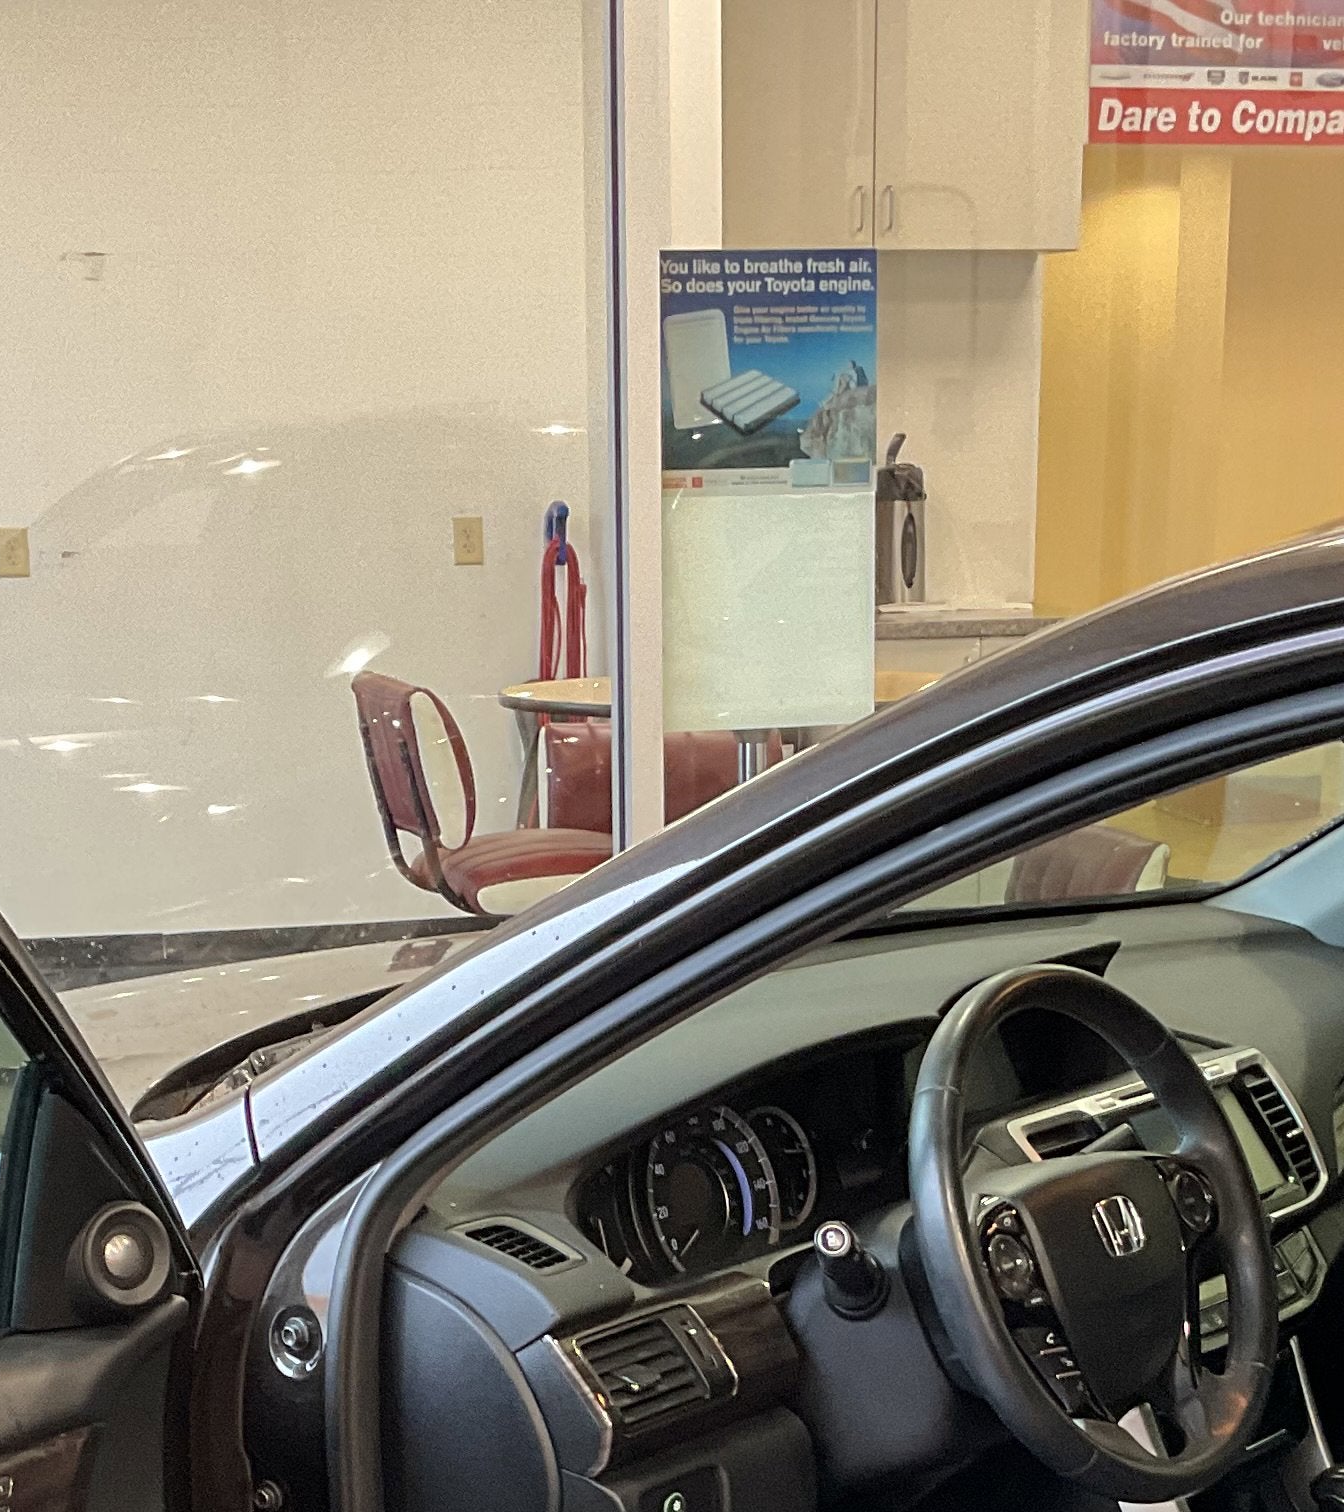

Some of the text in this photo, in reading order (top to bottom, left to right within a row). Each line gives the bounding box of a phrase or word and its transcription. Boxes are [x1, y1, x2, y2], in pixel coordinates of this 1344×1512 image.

[1220, 9, 1253, 26] Our
[1103, 31, 1166, 51] factory
[1171, 32, 1233, 49] trained
[1238, 33, 1264, 53] for
[1098, 98, 1177, 133] Dare
[1187, 101, 1221, 133] to
[660, 257, 872, 275] You like to breathe fresh air.
[660, 275, 874, 296] So does your Toyota engine.
